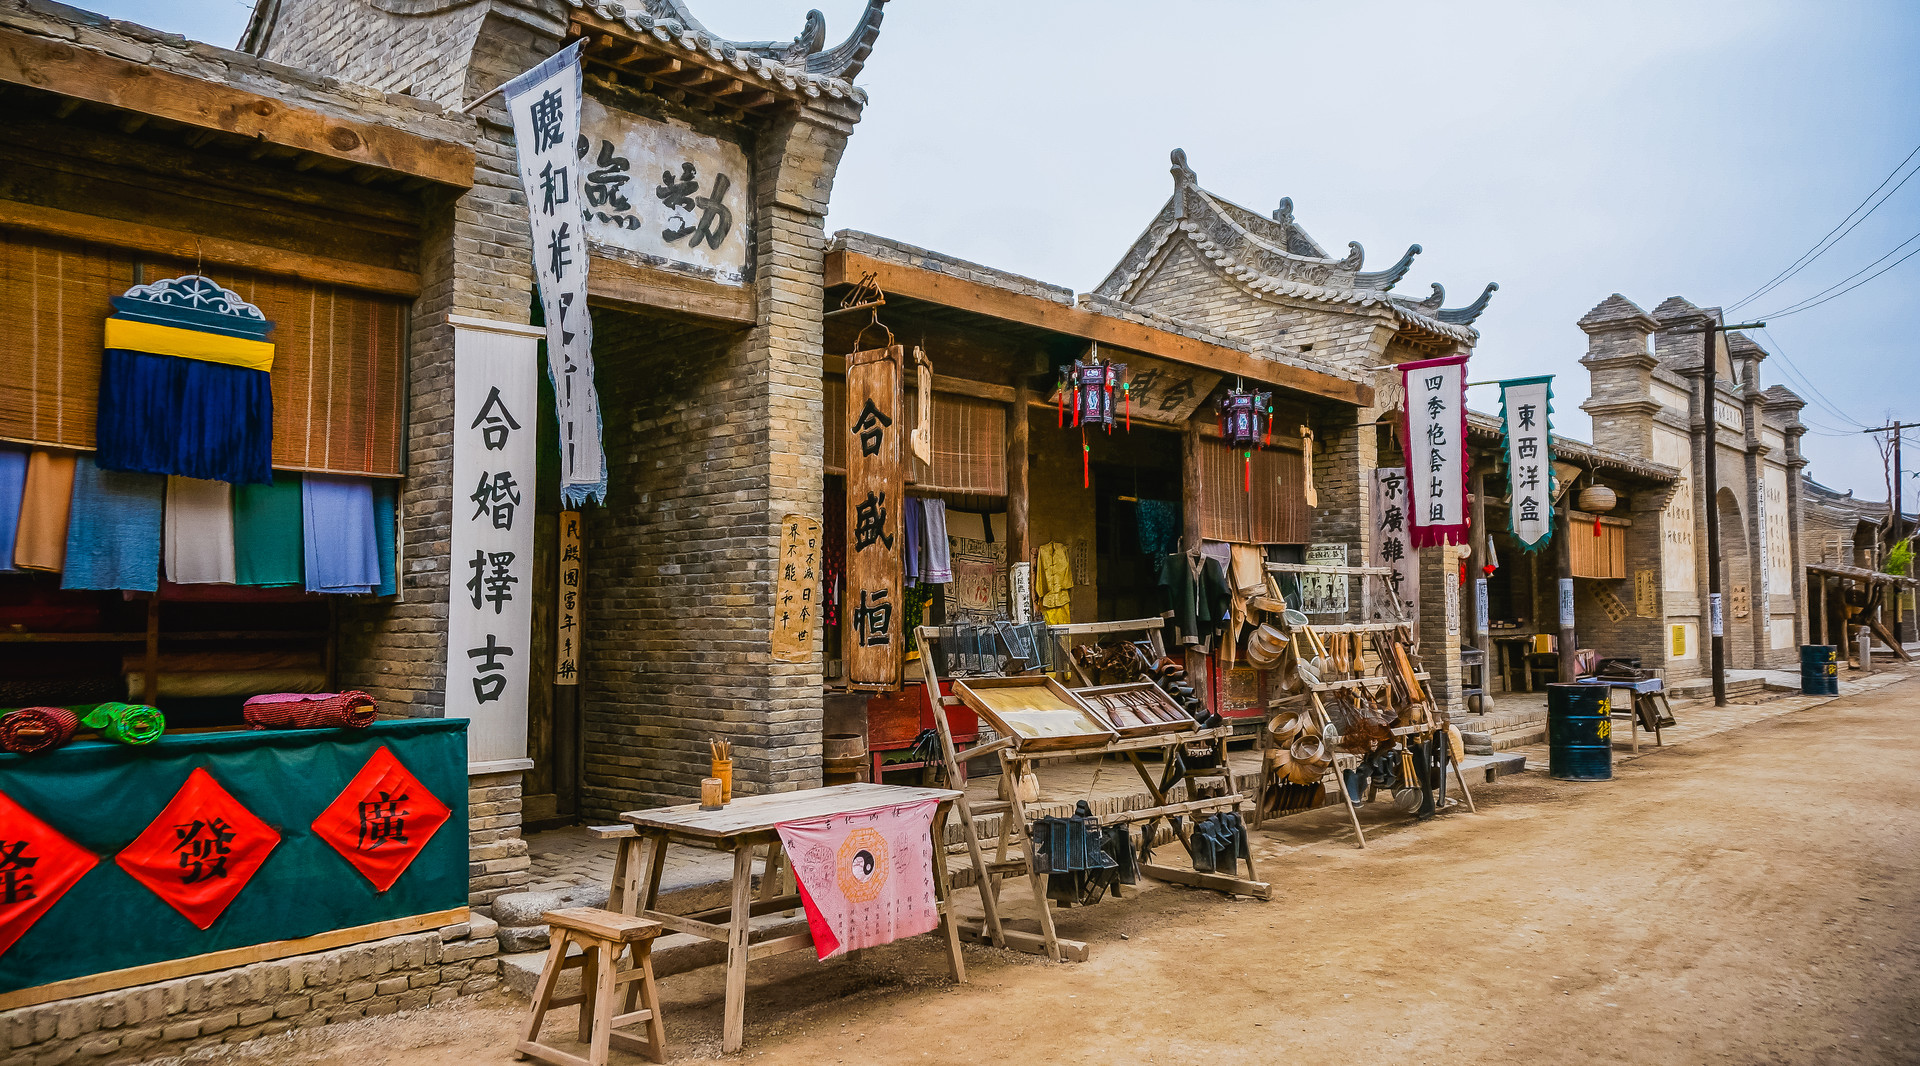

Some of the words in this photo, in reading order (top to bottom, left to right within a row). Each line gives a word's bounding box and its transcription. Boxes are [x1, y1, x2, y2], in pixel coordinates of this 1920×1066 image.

[1518, 403, 1540, 522] 東西洋盒
[466, 385, 522, 705] 合婚擇吉
[851, 398, 894, 647] 合盛恒
[172, 815, 238, 885] 發
[356, 791, 411, 852] 廣
